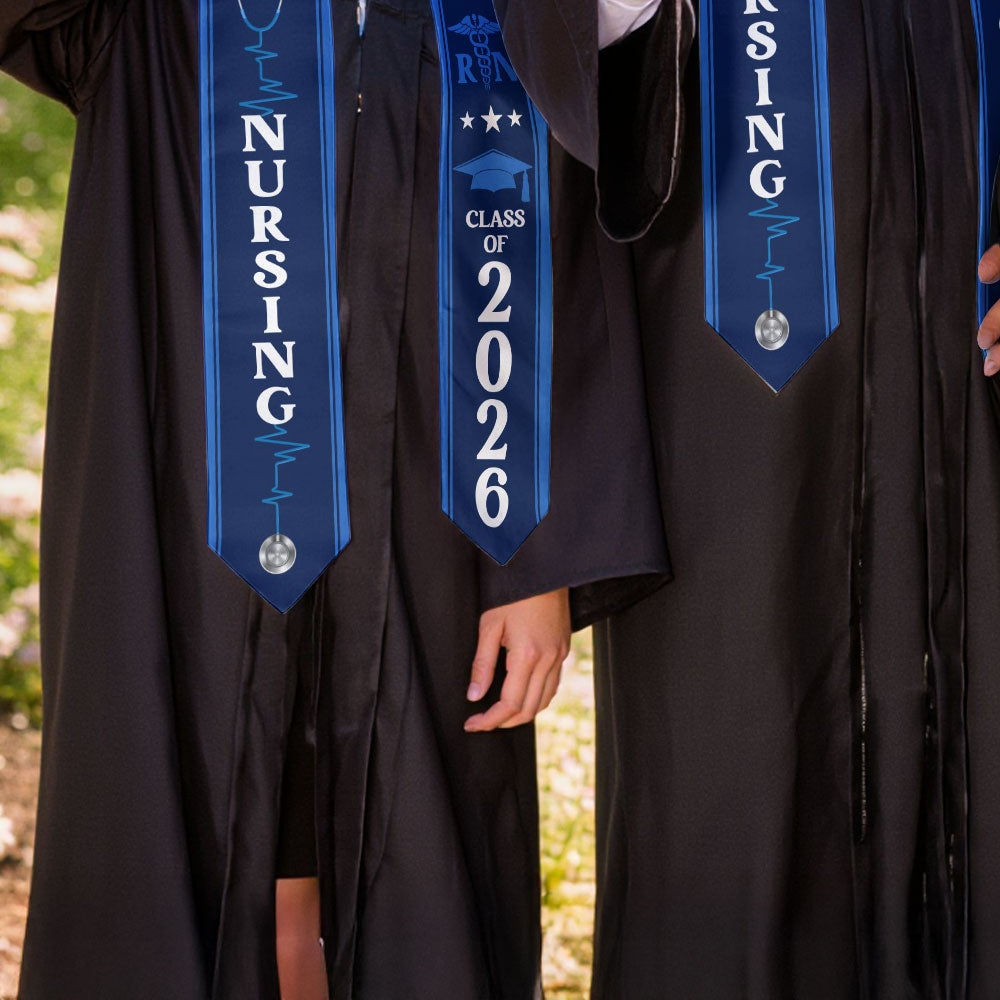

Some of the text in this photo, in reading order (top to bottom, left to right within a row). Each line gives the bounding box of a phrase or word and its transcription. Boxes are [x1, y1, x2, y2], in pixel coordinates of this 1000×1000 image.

[241, 113, 297, 425] NURSING
[465, 209, 526, 229] CLASS
[483, 235, 509, 253] OF
[474, 260, 513, 528] 2026
